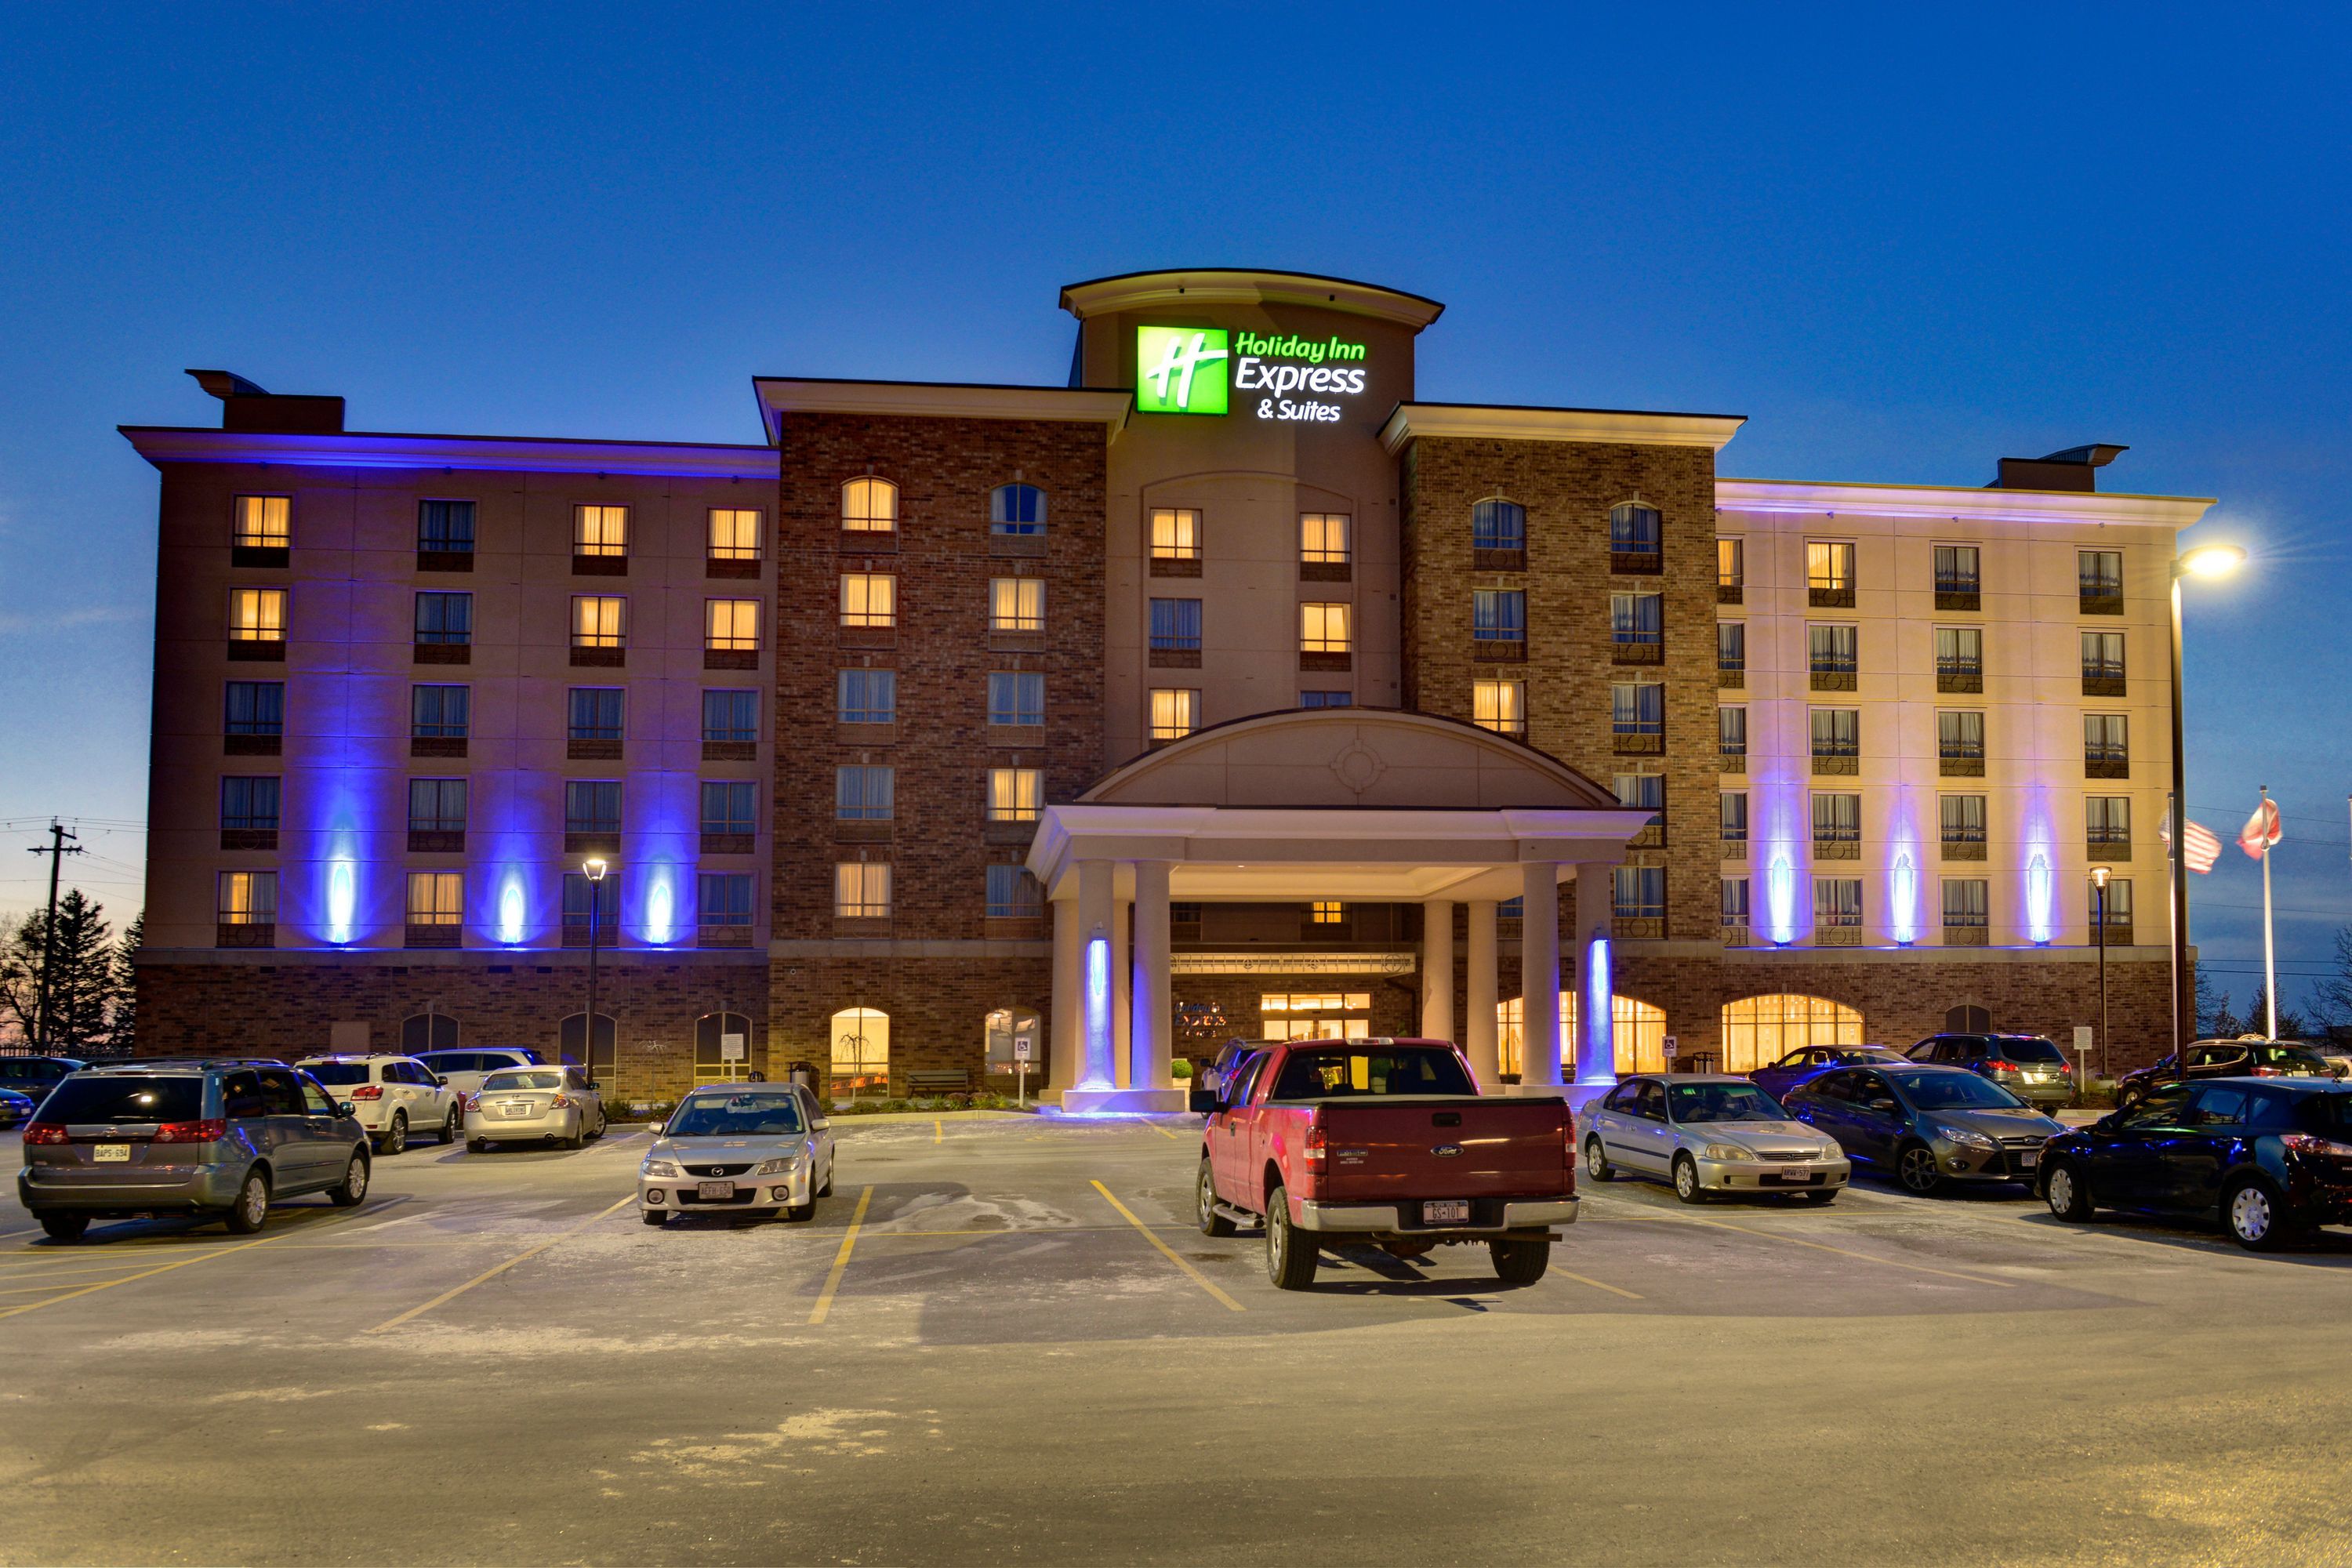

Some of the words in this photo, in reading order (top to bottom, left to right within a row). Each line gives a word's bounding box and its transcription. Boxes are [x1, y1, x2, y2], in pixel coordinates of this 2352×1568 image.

[1235, 332, 1326, 363] Holiday
[1328, 336, 1366, 360] Inn
[1235, 357, 1366, 398] Express
[1257, 398, 1274, 419] &
[1276, 399, 1341, 421] Suites
